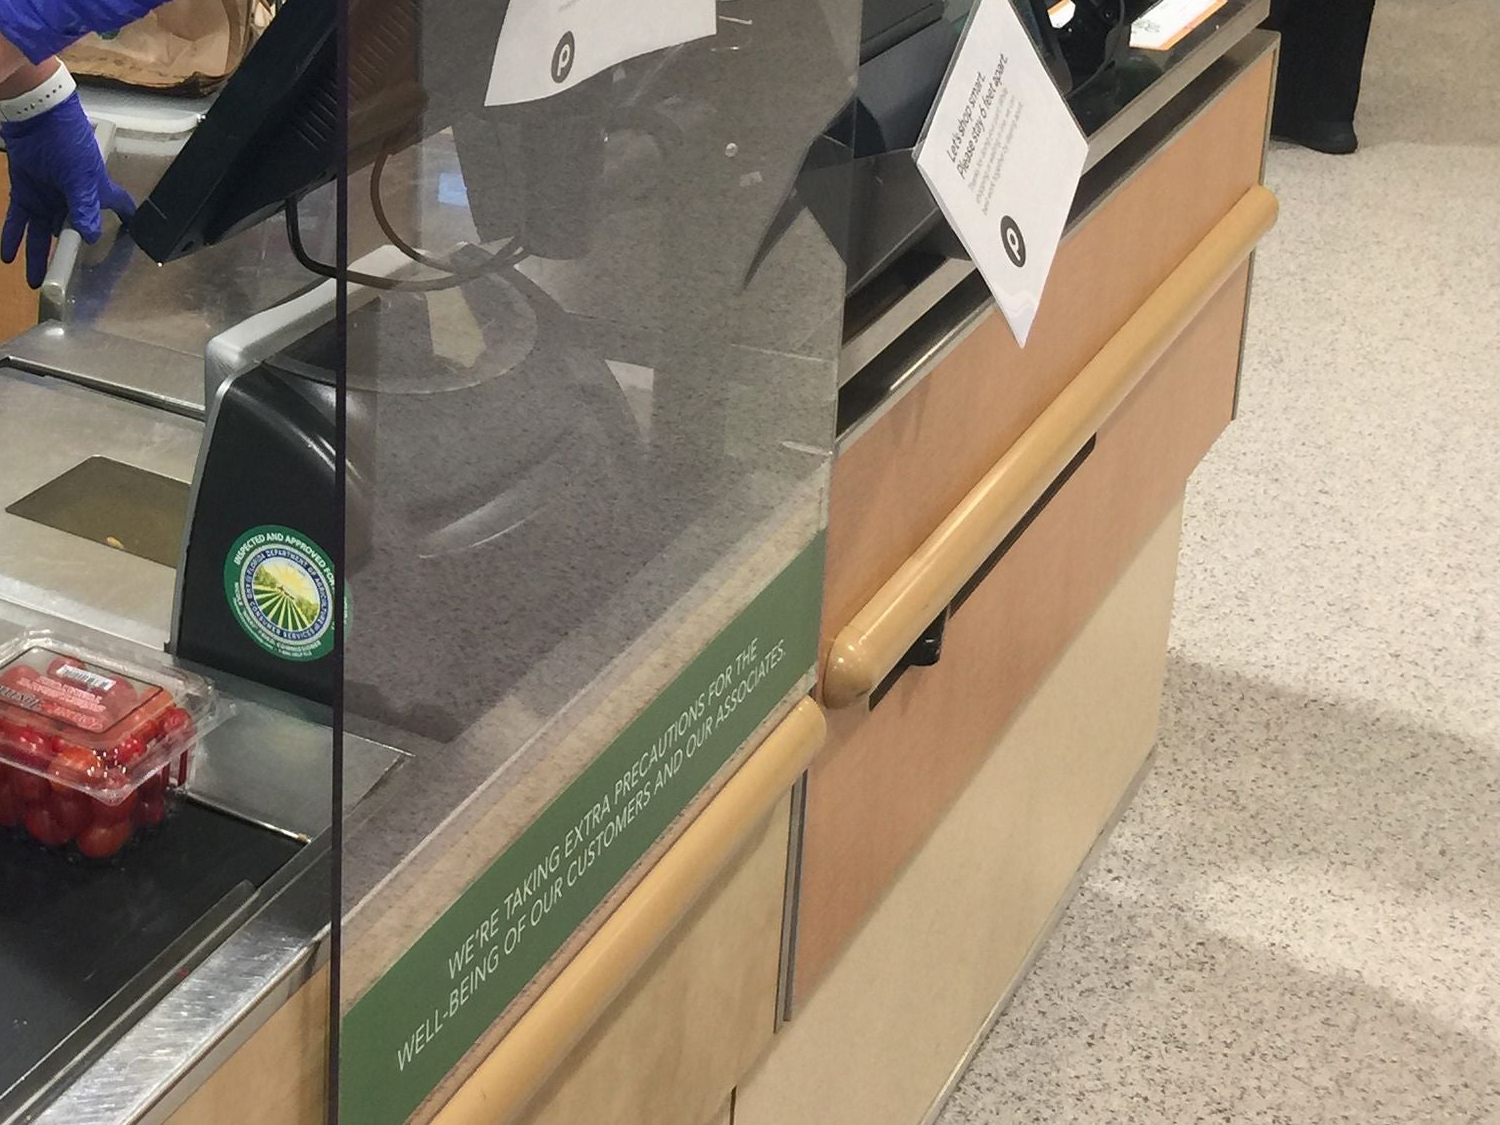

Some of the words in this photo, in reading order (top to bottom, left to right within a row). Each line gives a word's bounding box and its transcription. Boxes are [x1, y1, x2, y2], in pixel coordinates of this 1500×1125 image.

[978, 105, 988, 119] 6
[980, 80, 997, 110] feet
[946, 131, 963, 164] Let's
[957, 104, 973, 138] shop
[973, 115, 988, 144] stay
[956, 138, 977, 180] Please
[448, 908, 499, 980] WE'RE
[503, 845, 560, 921] TAKING
[564, 794, 611, 859] EXTRA
[613, 691, 706, 805] PRECAUTIONS
[707, 664, 734, 707] FOR
[734, 637, 759, 676] THE
[396, 945, 500, 1073] WELL-BEING
[503, 914, 527, 956] OF
[529, 875, 564, 927] OUR
[566, 780, 652, 888] CUSTOMERS
[652, 748, 683, 796] AND
[685, 716, 713, 759] OUR
[715, 638, 787, 728] ASSOCIATES.
